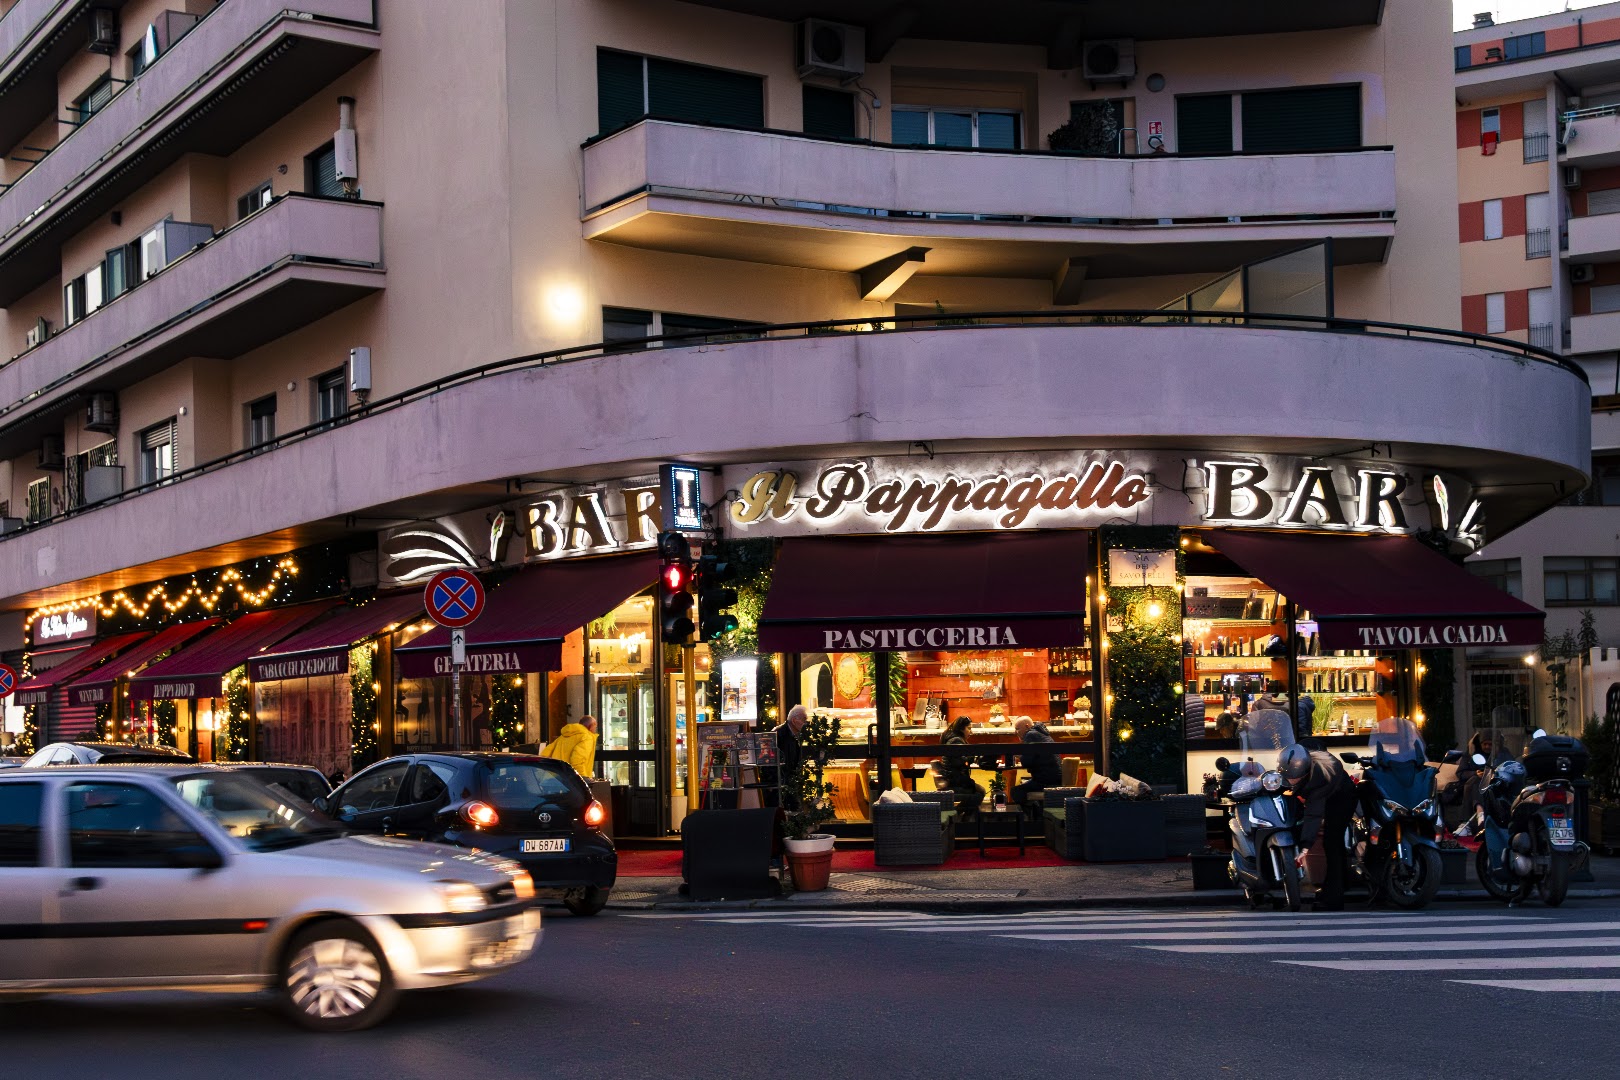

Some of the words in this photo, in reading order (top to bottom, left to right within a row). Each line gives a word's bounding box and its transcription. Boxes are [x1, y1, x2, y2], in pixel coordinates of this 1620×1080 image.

[676, 471, 695, 506] T
[731, 469, 799, 524] Il
[804, 459, 1152, 533] Pappagallo
[1204, 461, 1409, 529] BAR
[522, 486, 662, 558] BAR
[822, 626, 1019, 650] PASTICCERIA
[1358, 626, 1439, 646] TAVOLA
[1443, 624, 1509, 644] CALDA
[258, 658, 298, 680] TABACCHI
[299, 659, 307, 676] E
[307, 655, 340, 676] GIOCHI
[433, 652, 521, 674] GEATERIA
[153, 683, 174, 698] HAPPY
[174, 682, 195, 698] HOUR
[525, 840, 536, 852] DW
[538, 840, 565, 851] 687AA
